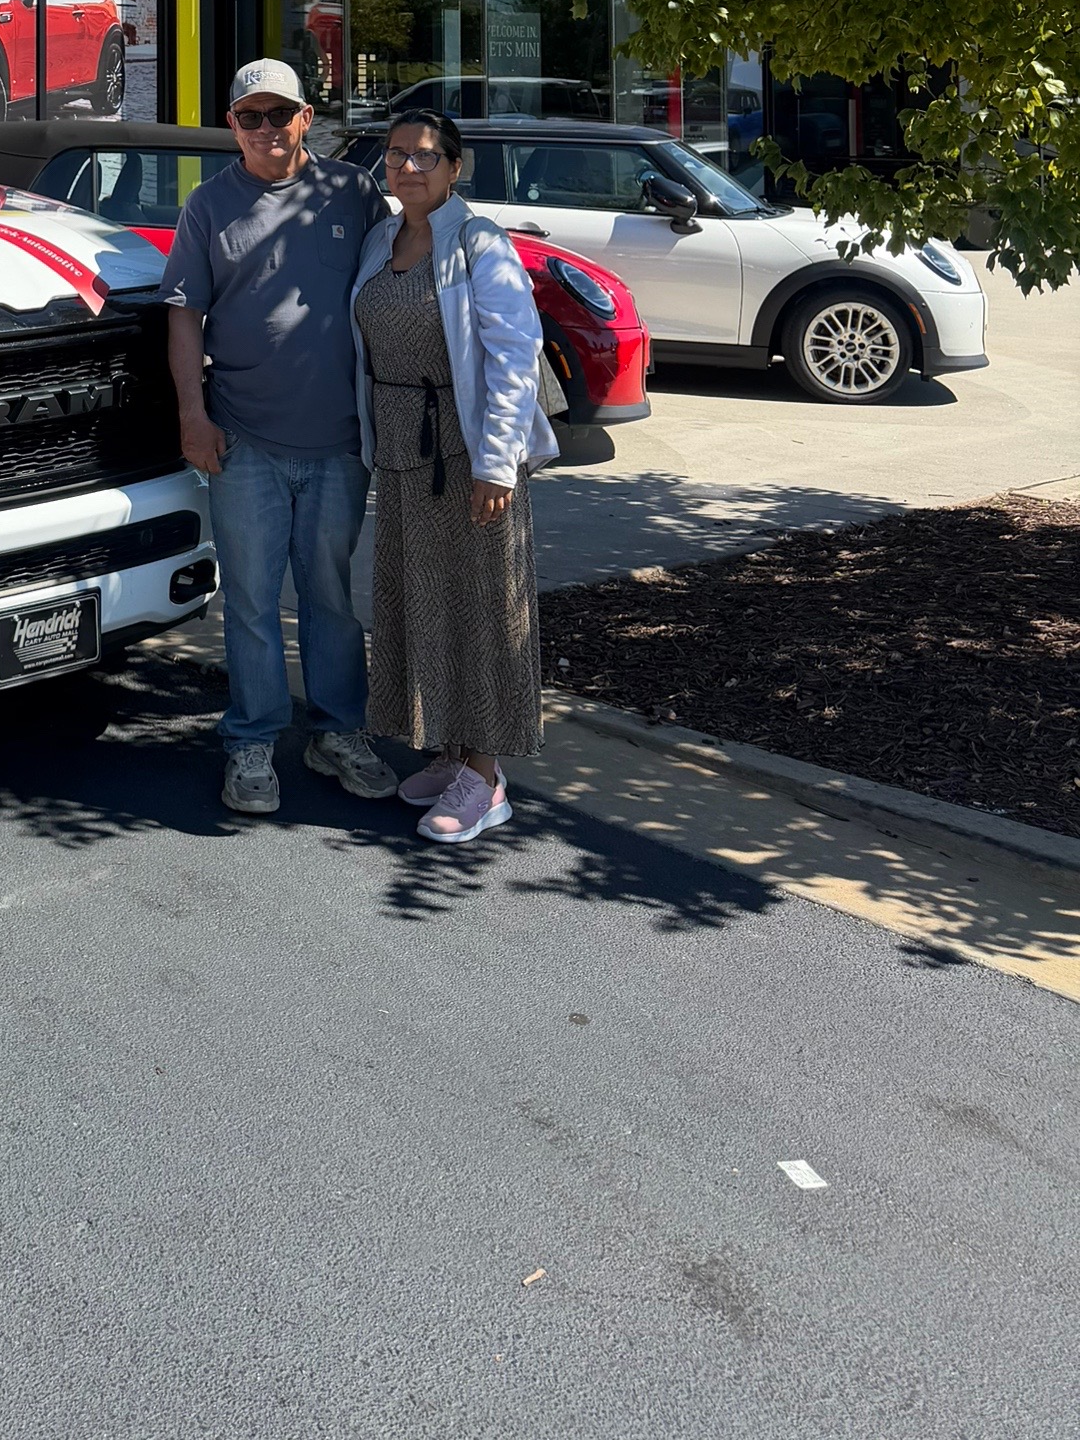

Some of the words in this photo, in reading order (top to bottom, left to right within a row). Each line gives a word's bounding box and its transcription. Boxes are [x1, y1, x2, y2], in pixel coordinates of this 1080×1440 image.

[489, 41, 513, 58] ET'S
[515, 42, 540, 58] MINI
[18, 235, 83, 277] Automotive
[13, 607, 82, 648] Hendrick
[24, 637, 43, 647] CARY
[43, 632, 61, 642] AUTO
[61, 629, 79, 637] MALL
